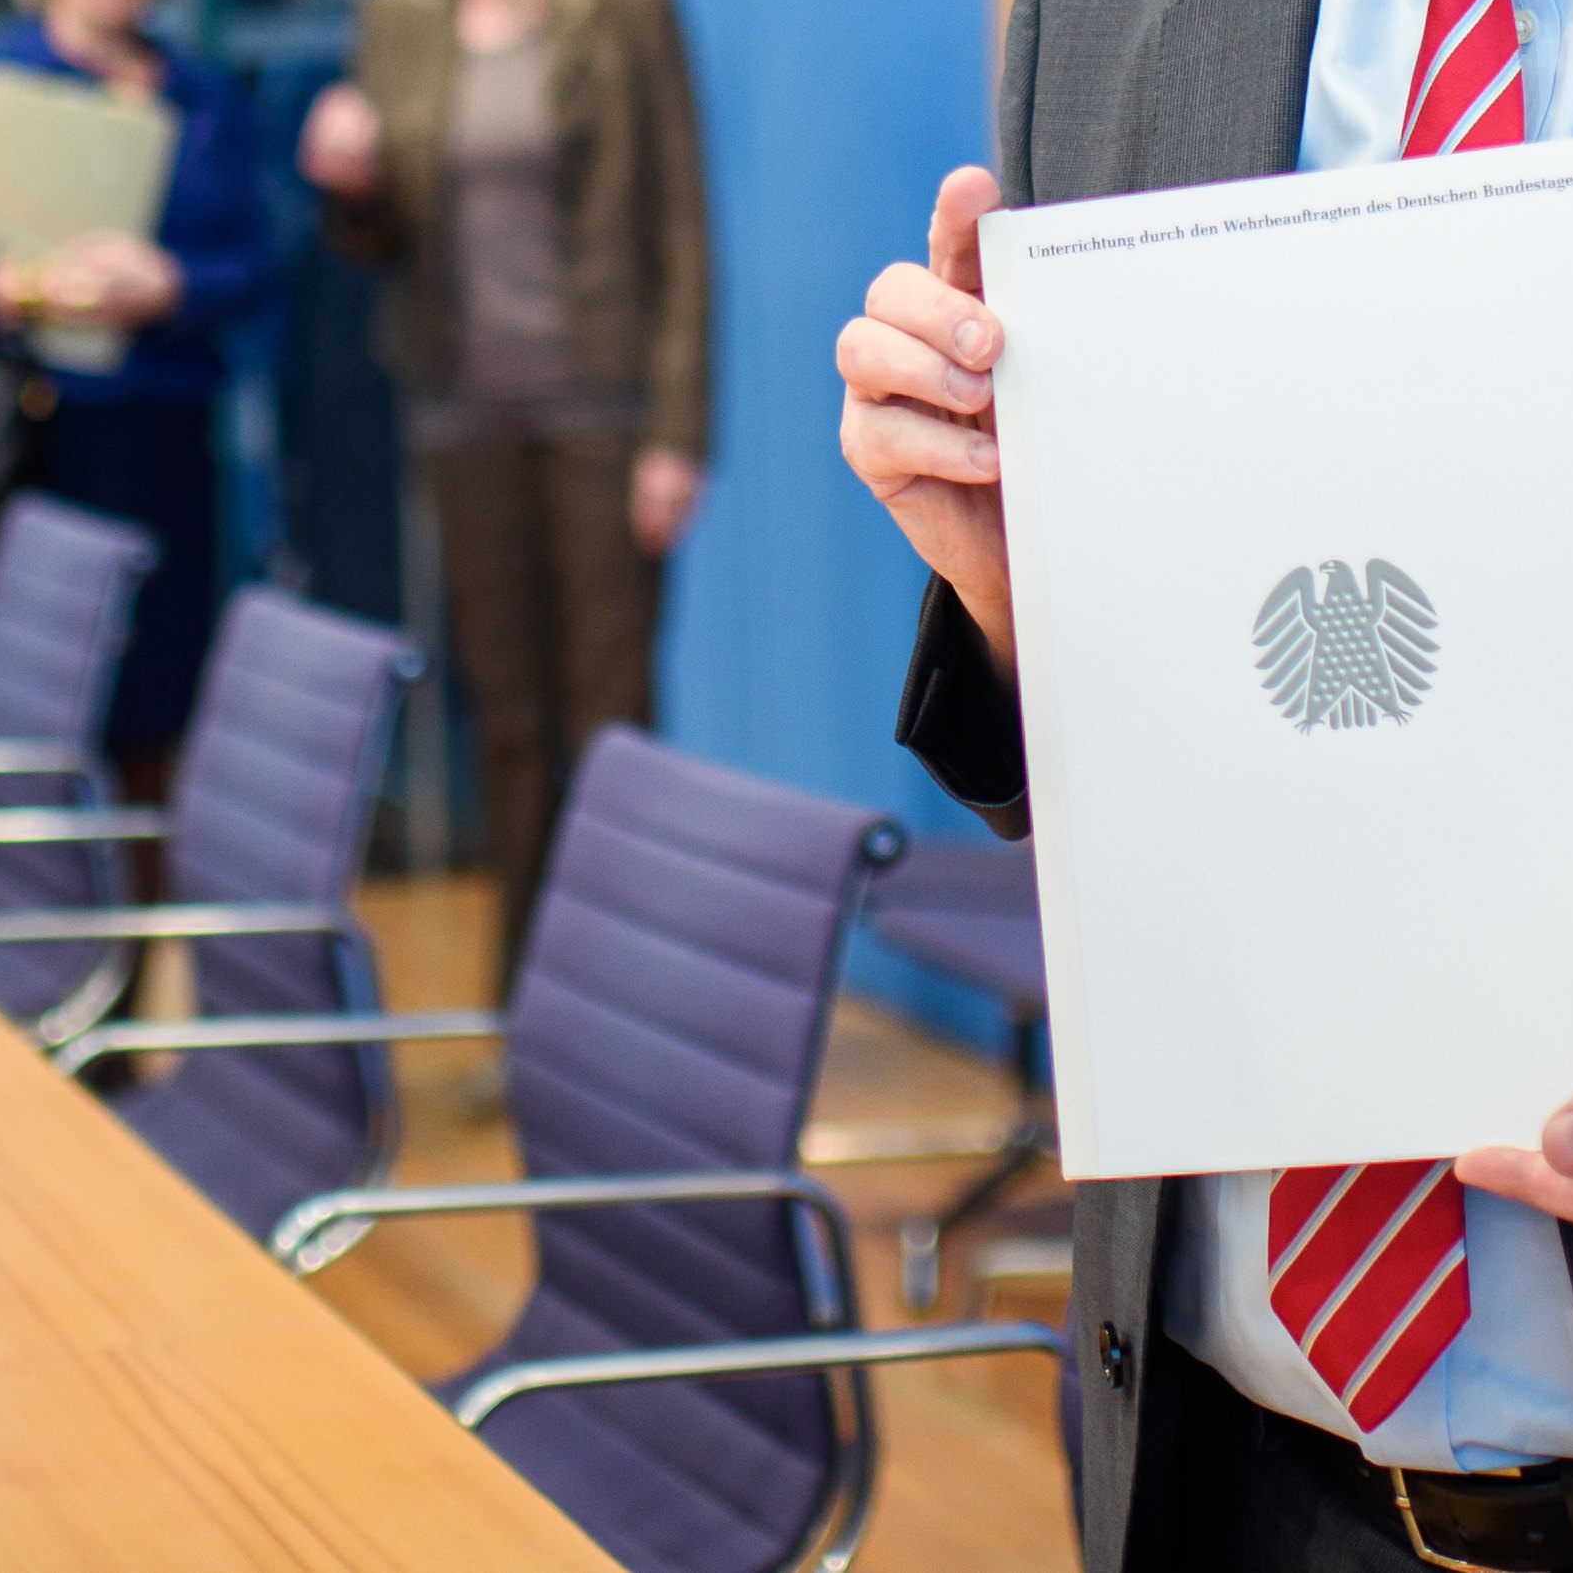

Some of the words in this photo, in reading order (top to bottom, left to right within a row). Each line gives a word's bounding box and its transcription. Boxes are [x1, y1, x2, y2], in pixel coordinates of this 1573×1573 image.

[1028, 236, 1136, 259] Unterrichtung
[1139, 225, 1185, 244] durch
[1190, 223, 1219, 238] den
[1223, 206, 1361, 233] Wehrbeauftragten
[1366, 199, 1392, 214] des
[1396, 188, 1478, 210] Deutschen
